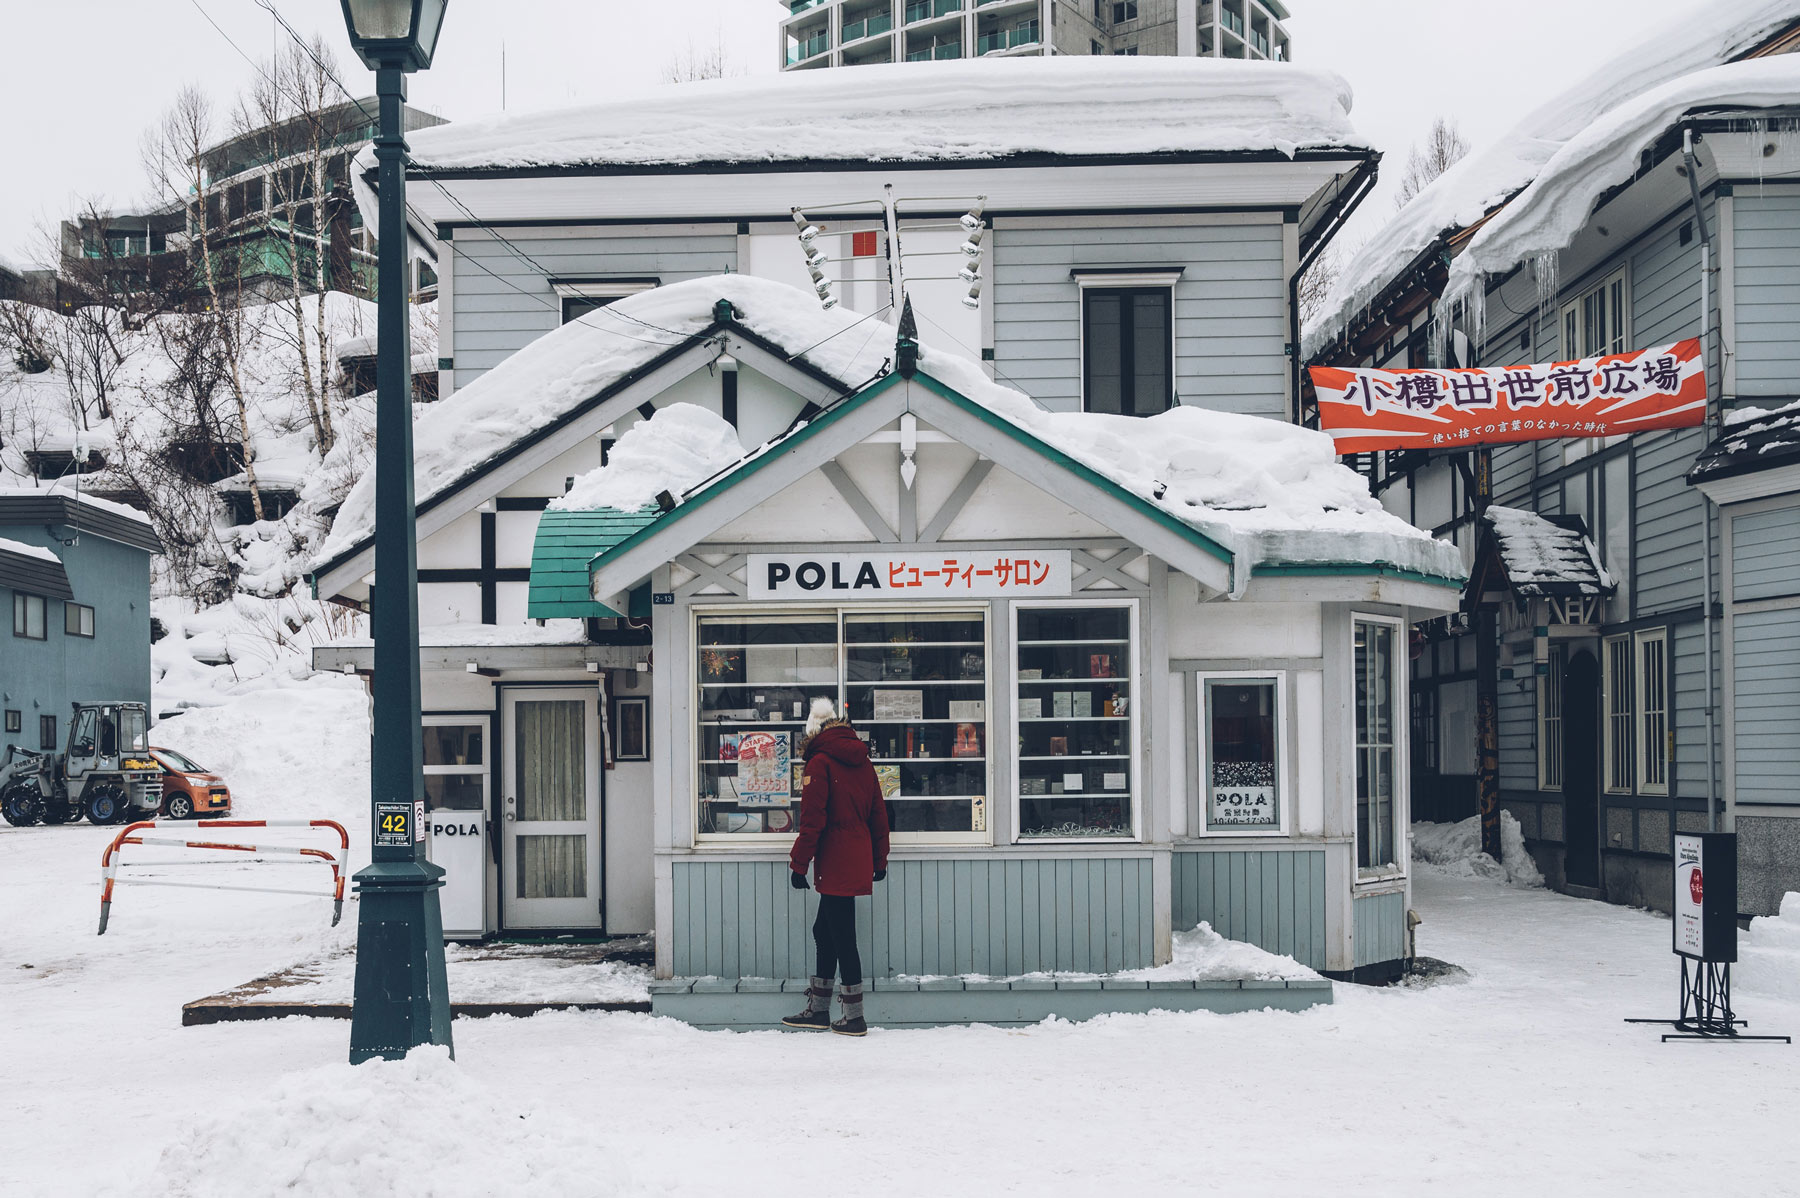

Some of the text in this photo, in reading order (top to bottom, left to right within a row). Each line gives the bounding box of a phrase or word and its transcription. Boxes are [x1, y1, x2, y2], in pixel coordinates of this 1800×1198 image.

[1343, 357, 1685, 411] 小樽出世前広場
[767, 558, 1050, 591] POLA ビューティーサロン
[655, 595, 672, 603] 2-13
[744, 737, 765, 748] STAFF
[1216, 792, 1268, 806] POLA
[382, 815, 405, 832] 42
[433, 823, 480, 837] POLA
